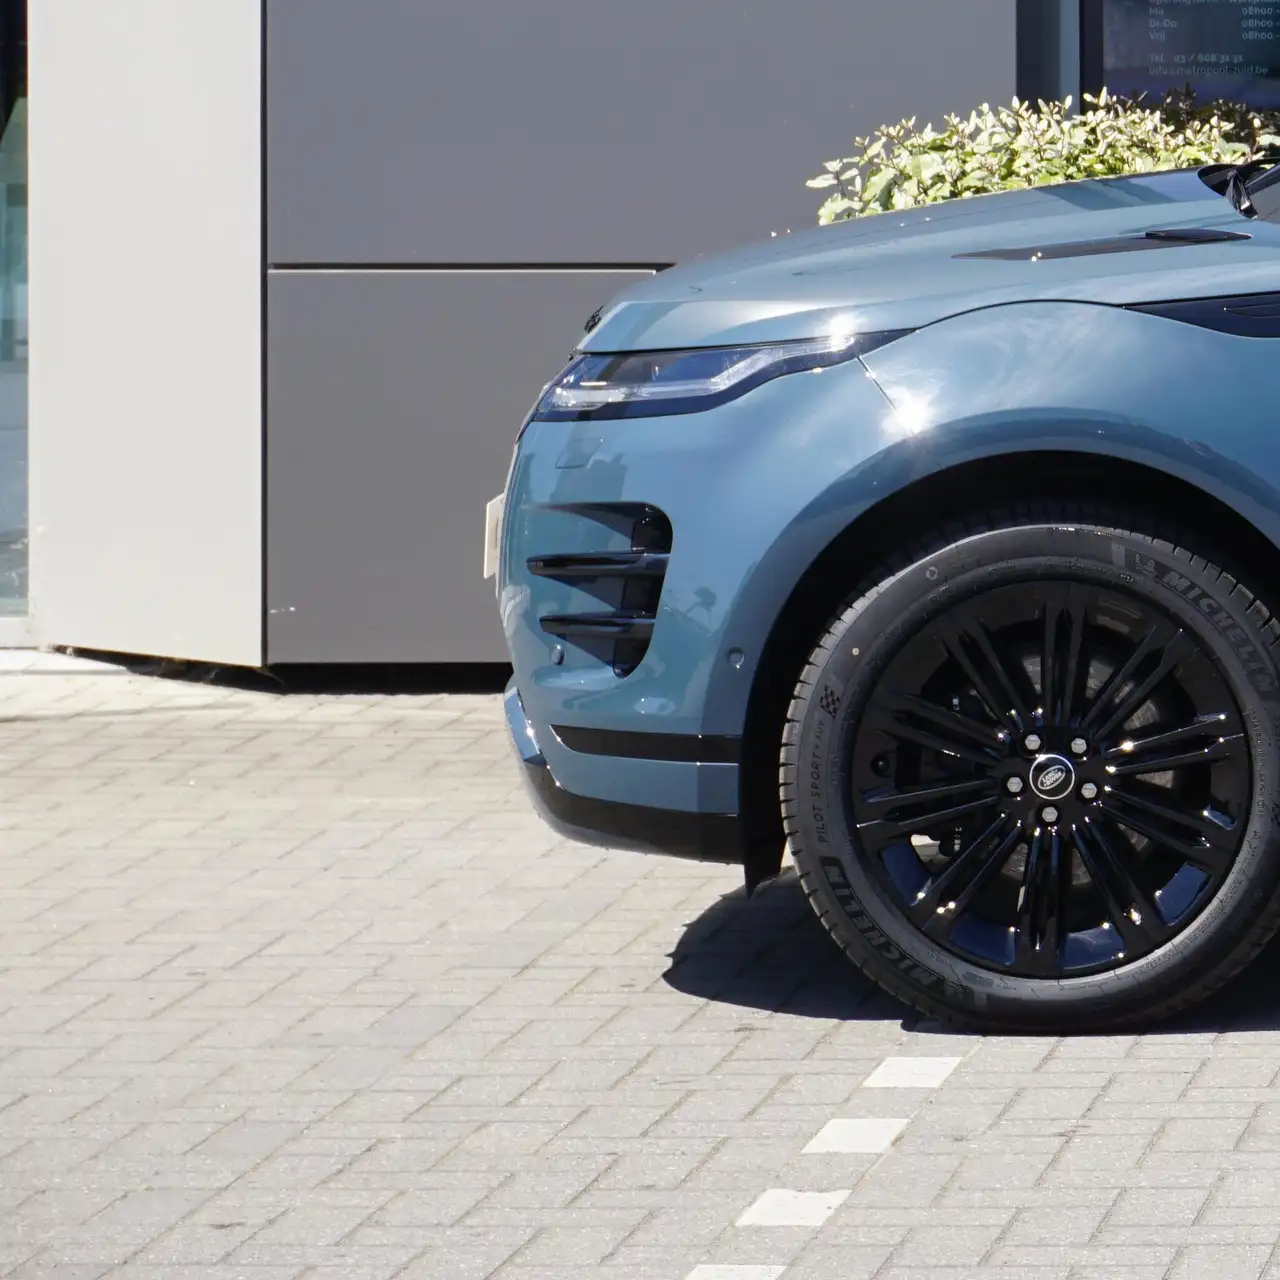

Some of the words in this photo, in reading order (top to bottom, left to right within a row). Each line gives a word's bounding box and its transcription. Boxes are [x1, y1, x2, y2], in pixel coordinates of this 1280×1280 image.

[1149, 7, 1164, 16] Ma
[1241, 6, 1273, 15] 08h00
[1149, 19, 1178, 28] Di-Do
[1241, 19, 1273, 28] 08h00
[1149, 31, 1166, 42] Vrij
[1241, 31, 1273, 40] 08h00
[1161, 569, 1274, 693] MICHELIN
[814, 719, 826, 742] SUV
[812, 803, 829, 844] PILOT
[823, 865, 939, 986] MICHELIN
